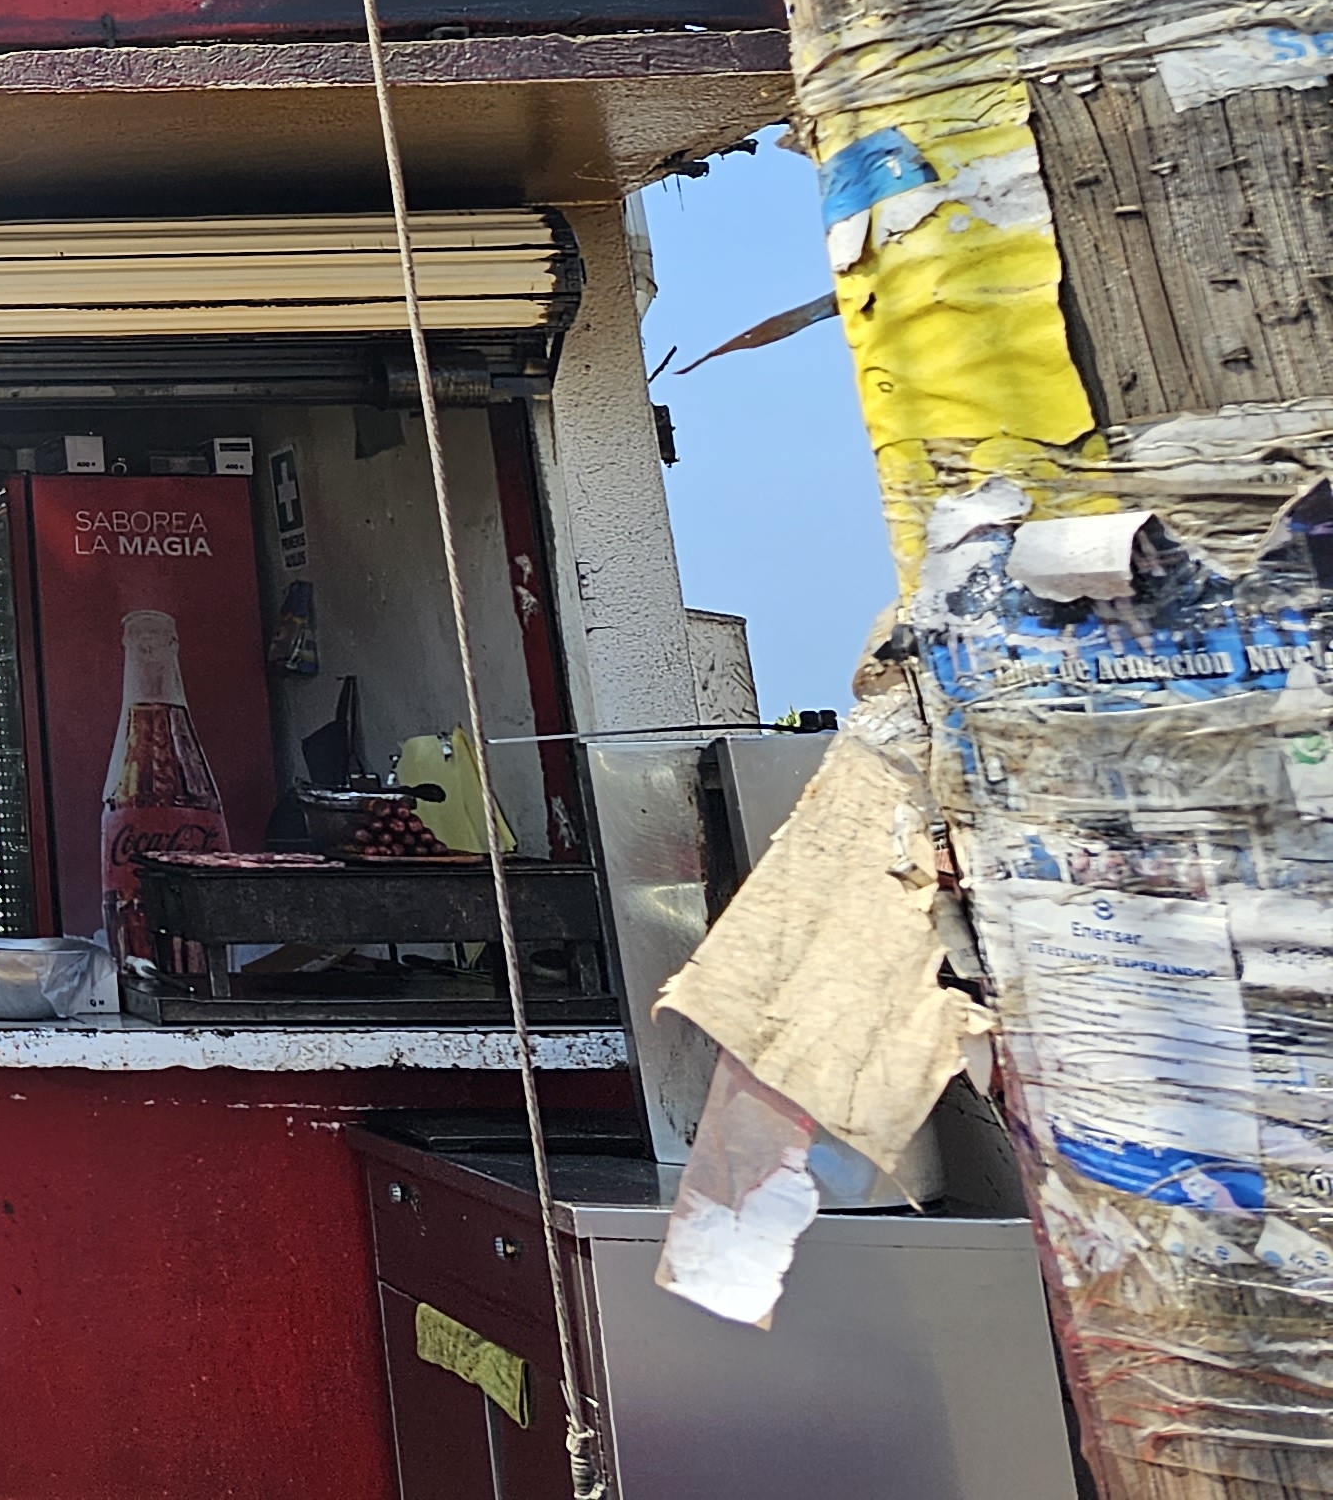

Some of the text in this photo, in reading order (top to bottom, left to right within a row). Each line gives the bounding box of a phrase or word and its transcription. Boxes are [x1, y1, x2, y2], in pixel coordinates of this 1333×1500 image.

[75, 510, 208, 533] SABOREA
[74, 535, 213, 557] LA MAGIA
[1071, 920, 1144, 946] Enerser
